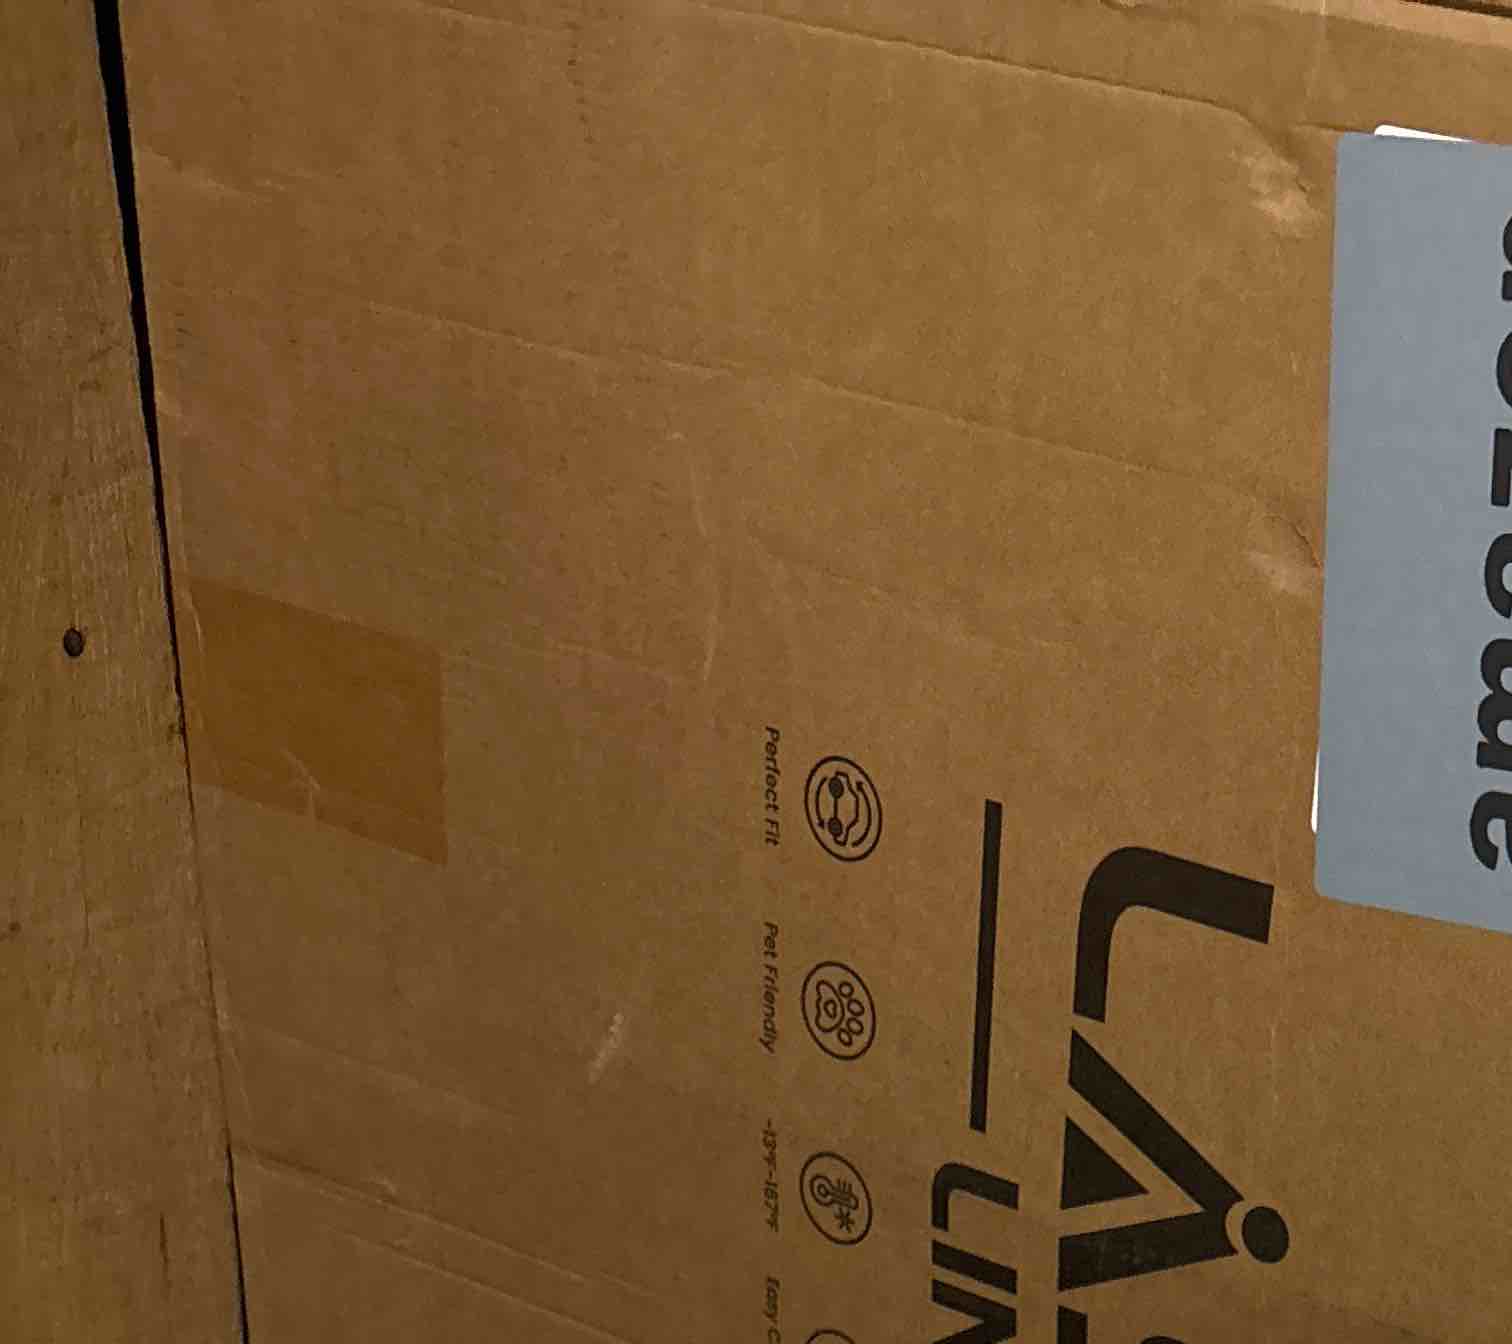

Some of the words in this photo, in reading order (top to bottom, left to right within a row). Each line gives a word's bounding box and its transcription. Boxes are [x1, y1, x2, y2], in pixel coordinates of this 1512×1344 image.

[764, 726, 782, 811] Perfect
[764, 816, 781, 847] Fit
[763, 921, 779, 959] Pet
[759, 965, 779, 1054] Friendly
[763, 1276, 782, 1321] Easy
